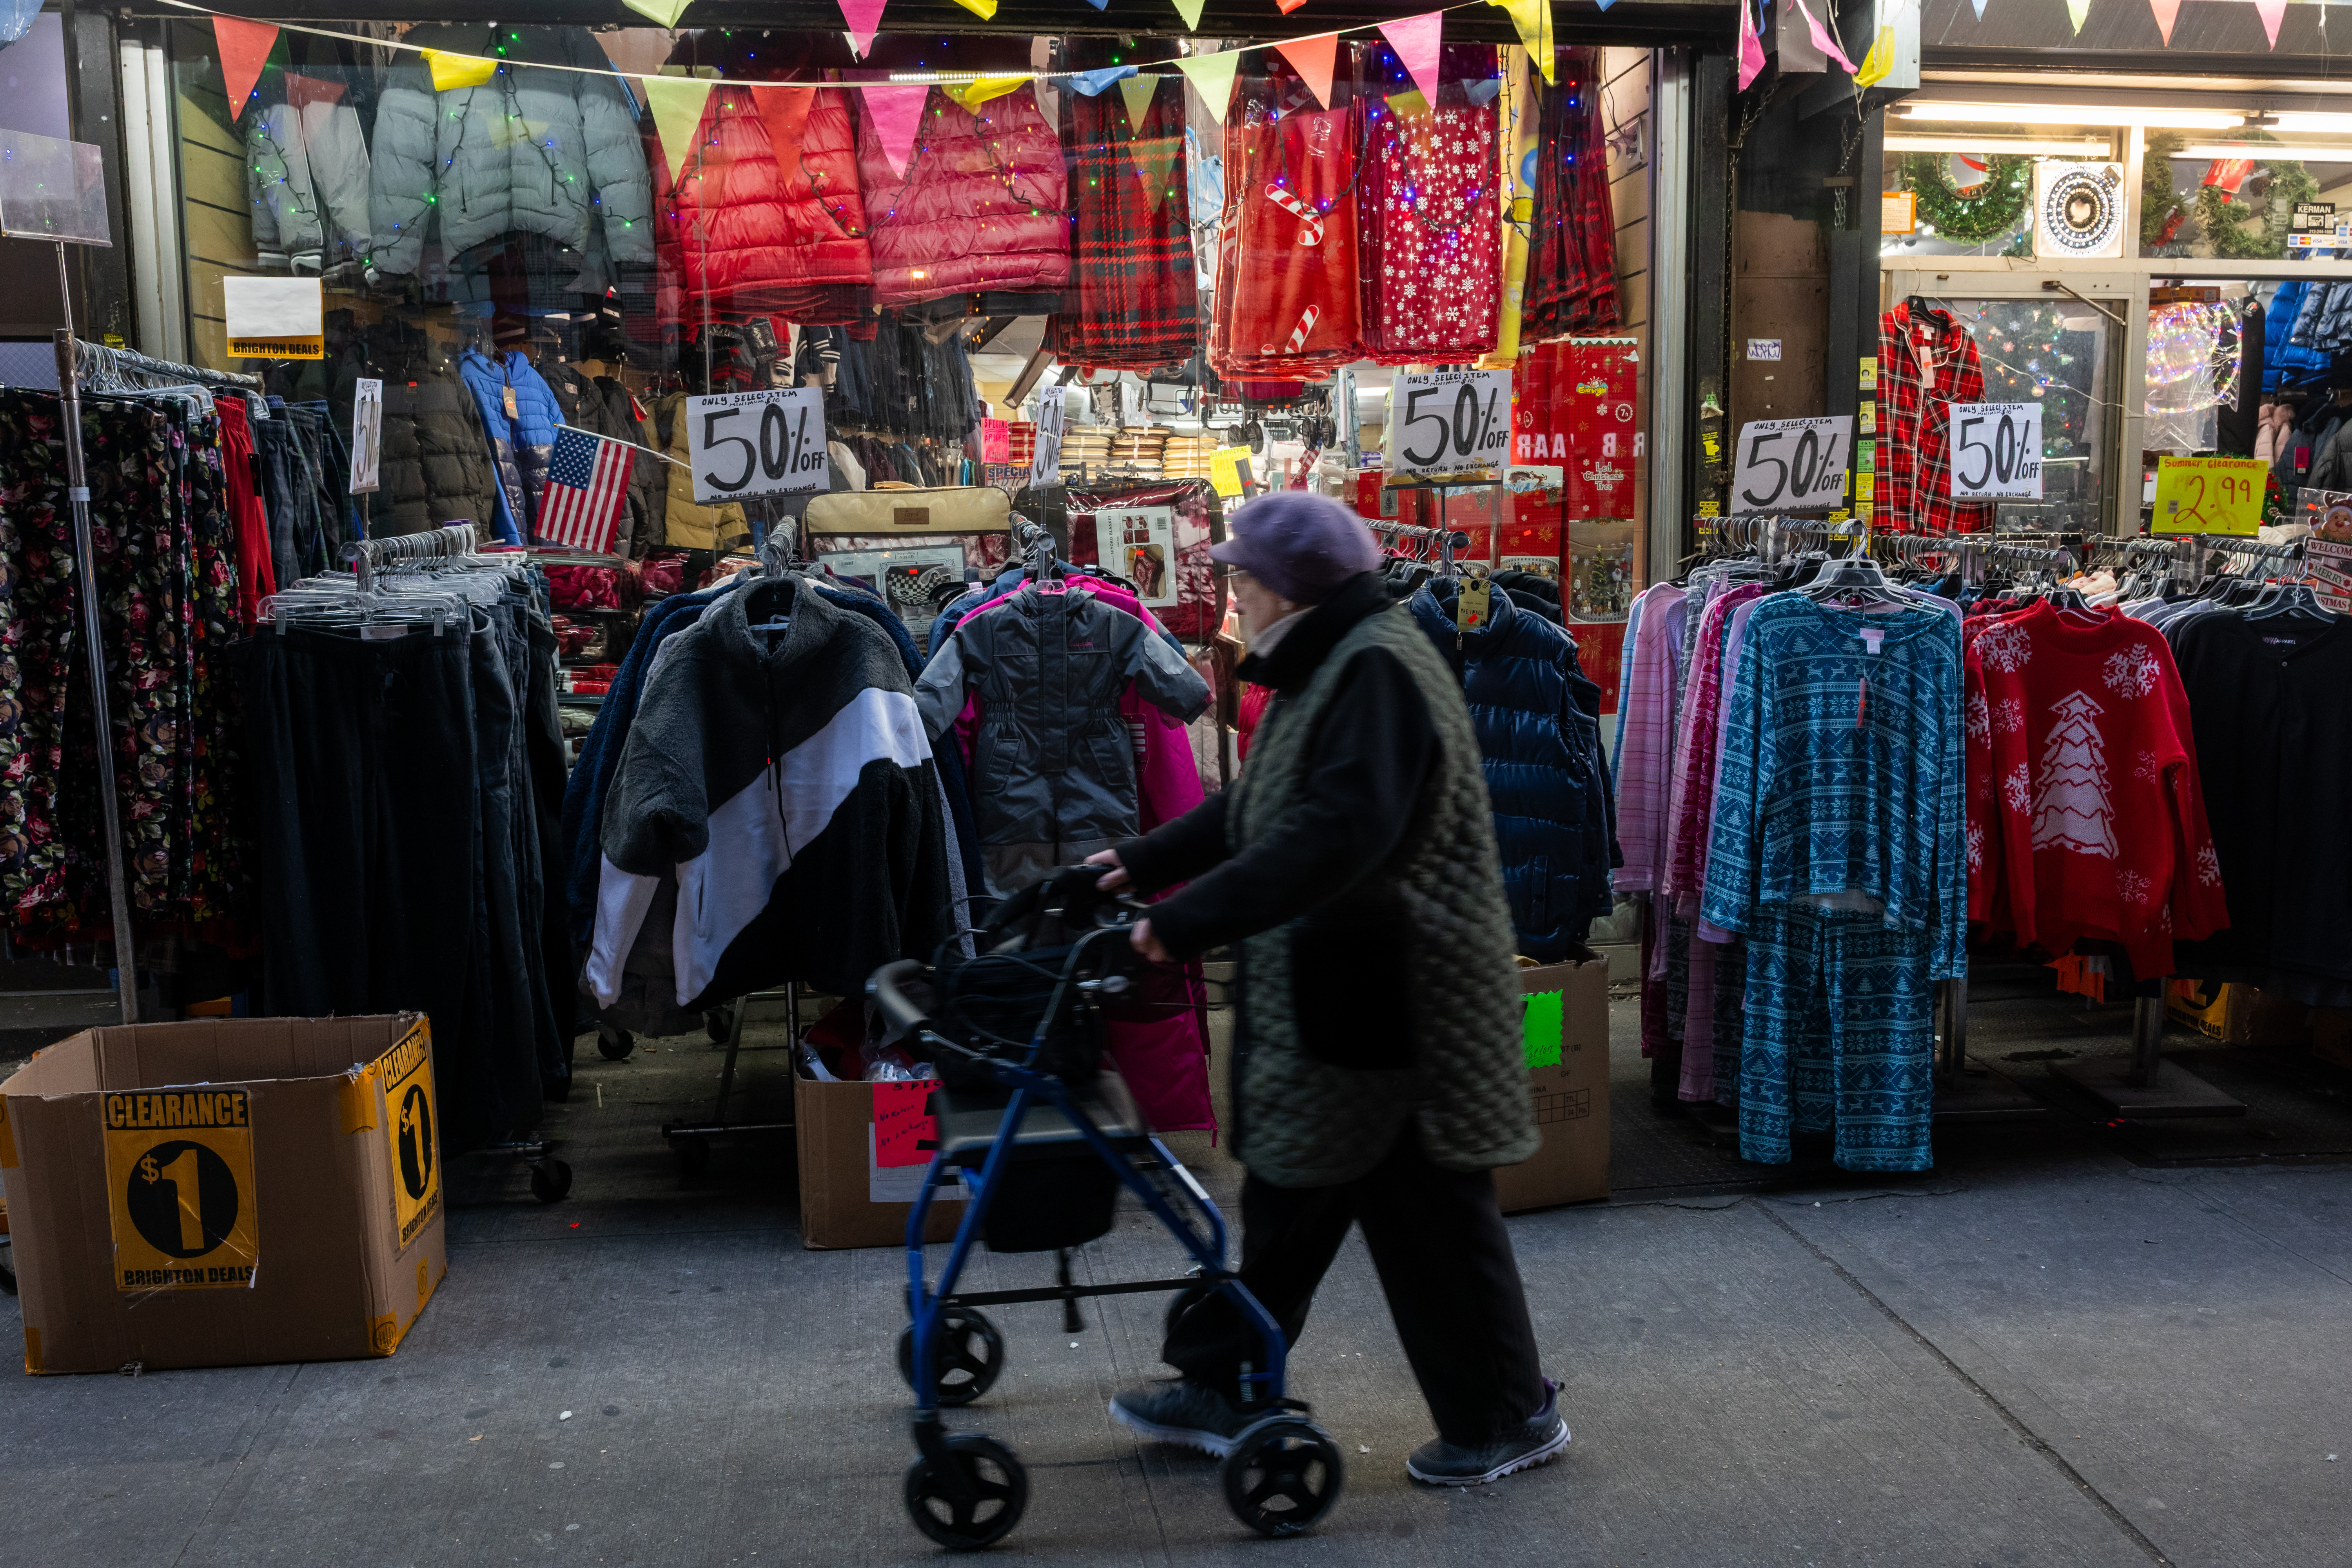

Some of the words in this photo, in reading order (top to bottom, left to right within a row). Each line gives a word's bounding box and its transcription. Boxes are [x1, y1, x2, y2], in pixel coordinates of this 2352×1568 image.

[233, 342, 286, 354] BRIGHTON
[289, 343, 319, 355] DEALS
[1408, 376, 1428, 384] ONLY
[1578, 386, 1607, 397] Everbright
[702, 397, 728, 405] ONLY
[984, 419, 1007, 428] SPECIAL
[1402, 383, 1497, 466] 50%
[1487, 431, 1509, 449] OFF
[1036, 398, 1062, 479] 50%
[704, 403, 810, 492] 50%
[800, 452, 825, 471] OFF
[1958, 414, 2030, 490] 50%
[2022, 462, 2039, 479] OFF
[1215, 456, 1243, 472] PRIC
[1466, 461, 1499, 469] EXCHANGE
[1595, 462, 1612, 472] Led
[1742, 429, 1837, 507] 50%
[1822, 474, 1843, 491] OFF
[2164, 459, 2202, 468] Summer
[2207, 459, 2257, 468] Clearance
[987, 465, 1032, 478] SPECIA
[1583, 471, 1624, 481] Christmas
[779, 483, 816, 493] EXCHANGE
[1215, 481, 1240, 495] MARK
[1595, 481, 1612, 490] Tree
[2173, 475, 2250, 524] 2.99
[2311, 542, 2352, 556] WELCOM
[2313, 565, 2345, 584] MERRY
[2318, 596, 2347, 608] ISTMAS
[2168, 1005, 2199, 1027] BRIGHTON
[2200, 1019, 2221, 1036] DEALS
[1571, 1044, 1581, 1052] (B)
[384, 1032, 426, 1090] CLEARANCE
[893, 1081, 941, 1091] SPEC
[1530, 1086, 1546, 1094] HINA
[108, 1093, 245, 1127] CLEARANCE
[880, 1110, 889, 1122] No
[402, 1091, 425, 1190] $1
[880, 1137, 889, 1147] No
[140, 1149, 204, 1250] $1
[402, 1207, 426, 1243] BRIGHTON
[426, 1189, 438, 1219] DEALS
[124, 1267, 205, 1285] BRIGHTON
[208, 1266, 254, 1282] DEALS
